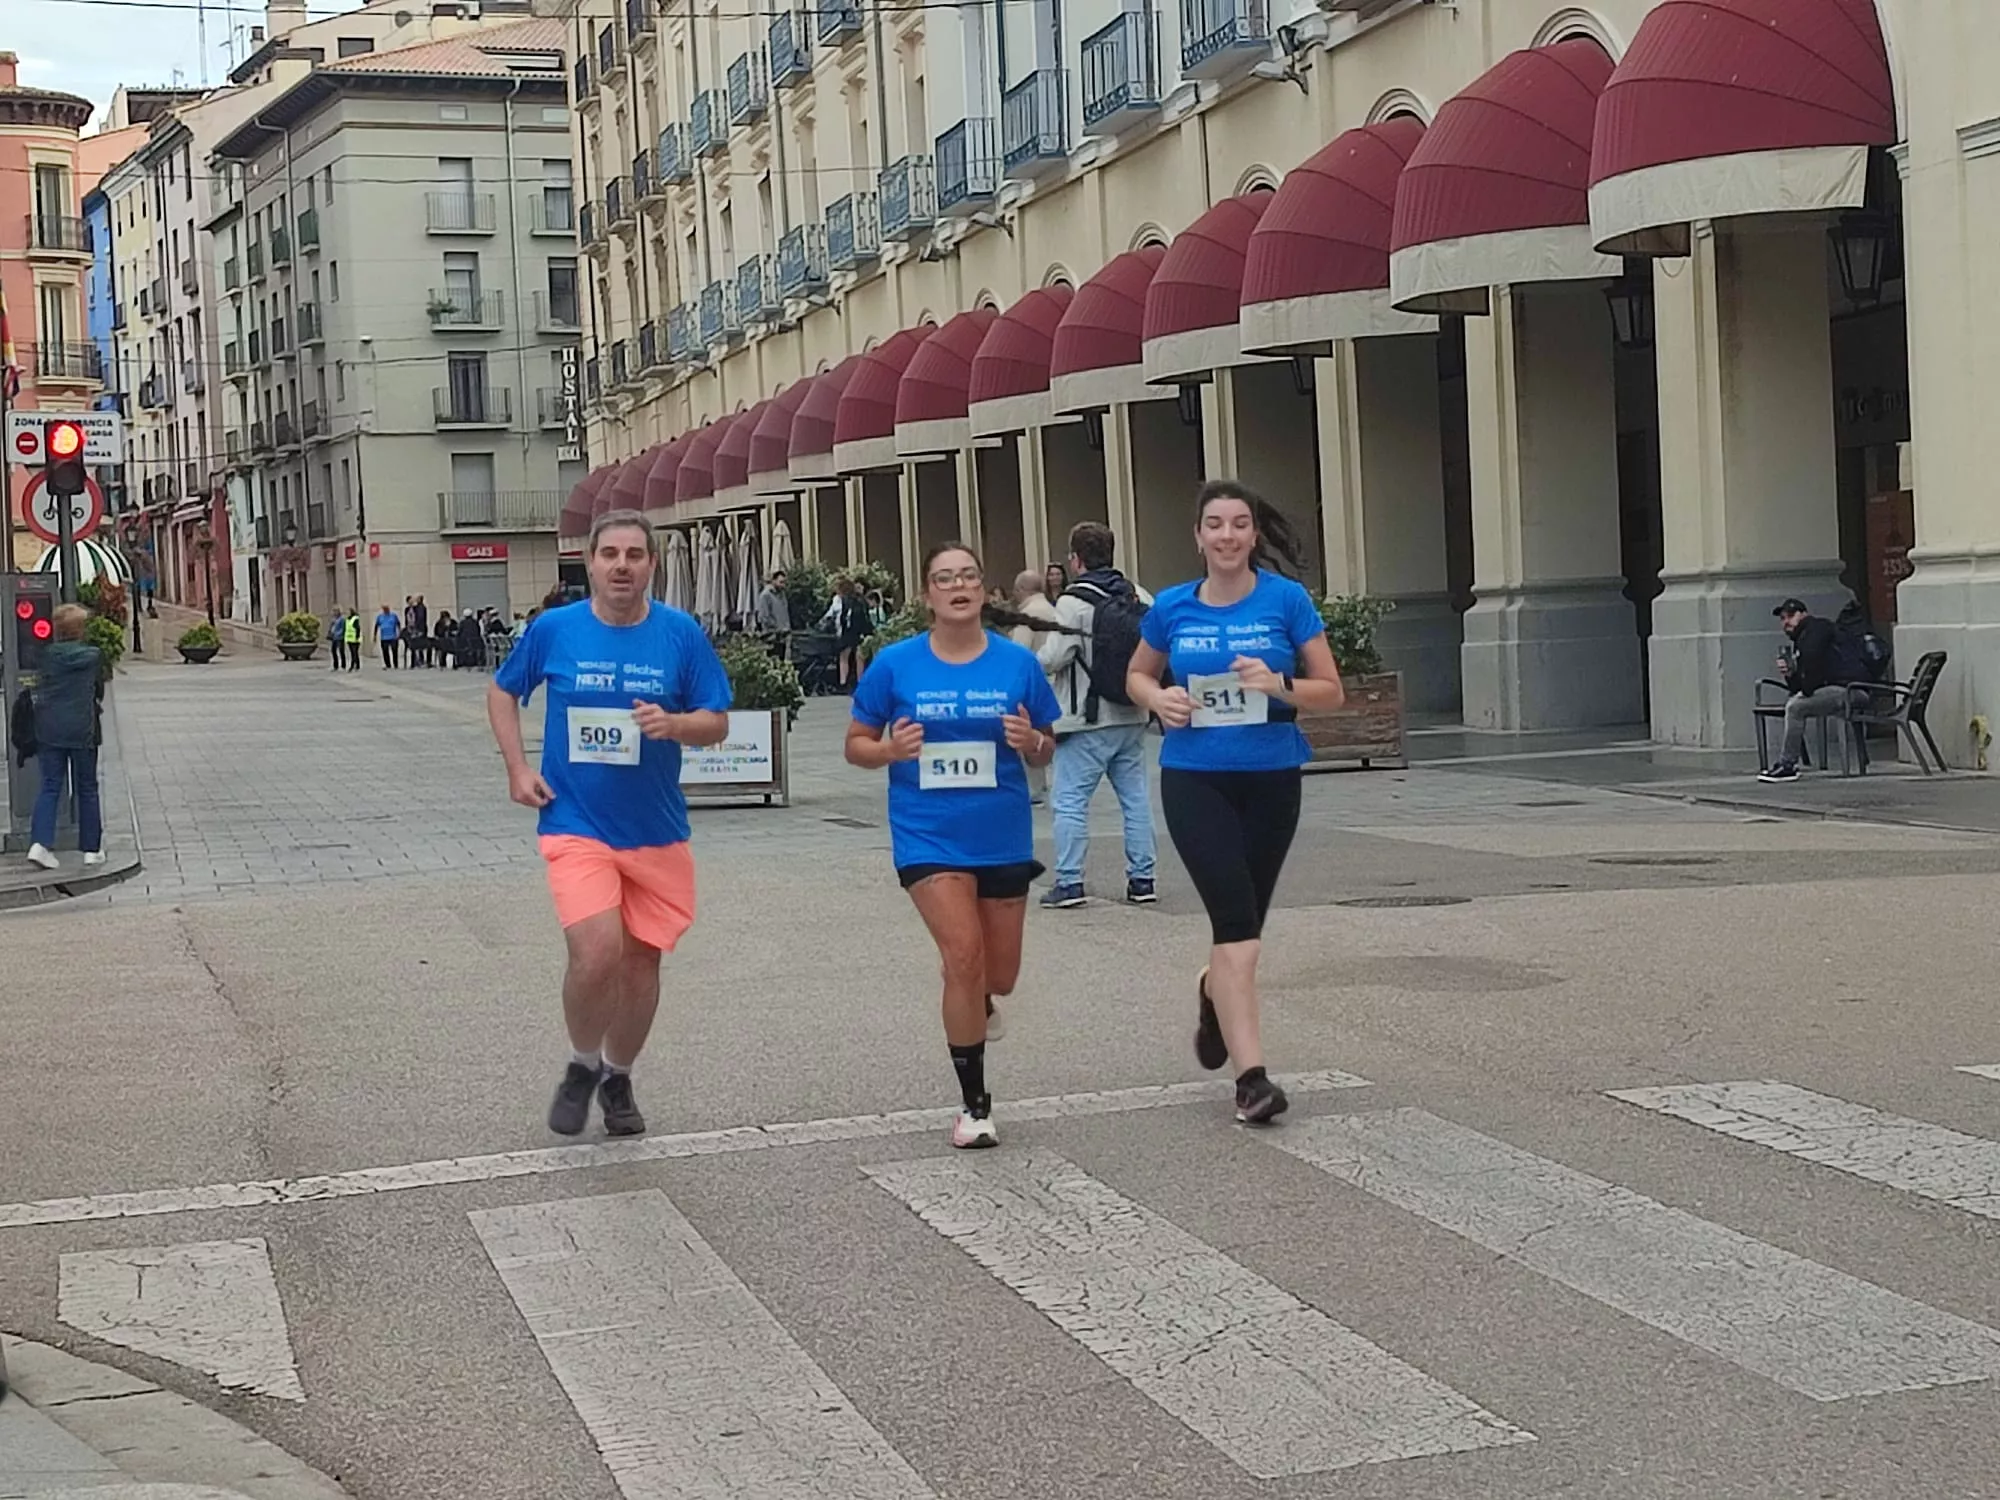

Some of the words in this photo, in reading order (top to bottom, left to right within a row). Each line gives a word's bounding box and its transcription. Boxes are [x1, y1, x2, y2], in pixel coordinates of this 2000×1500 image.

[563, 347, 579, 442] HOSTAL
[15, 418, 42, 426] ZONA
[467, 546, 493, 557] GAES
[1203, 688, 1246, 708] 511
[580, 726, 622, 745] 509
[932, 758, 978, 775] 510
